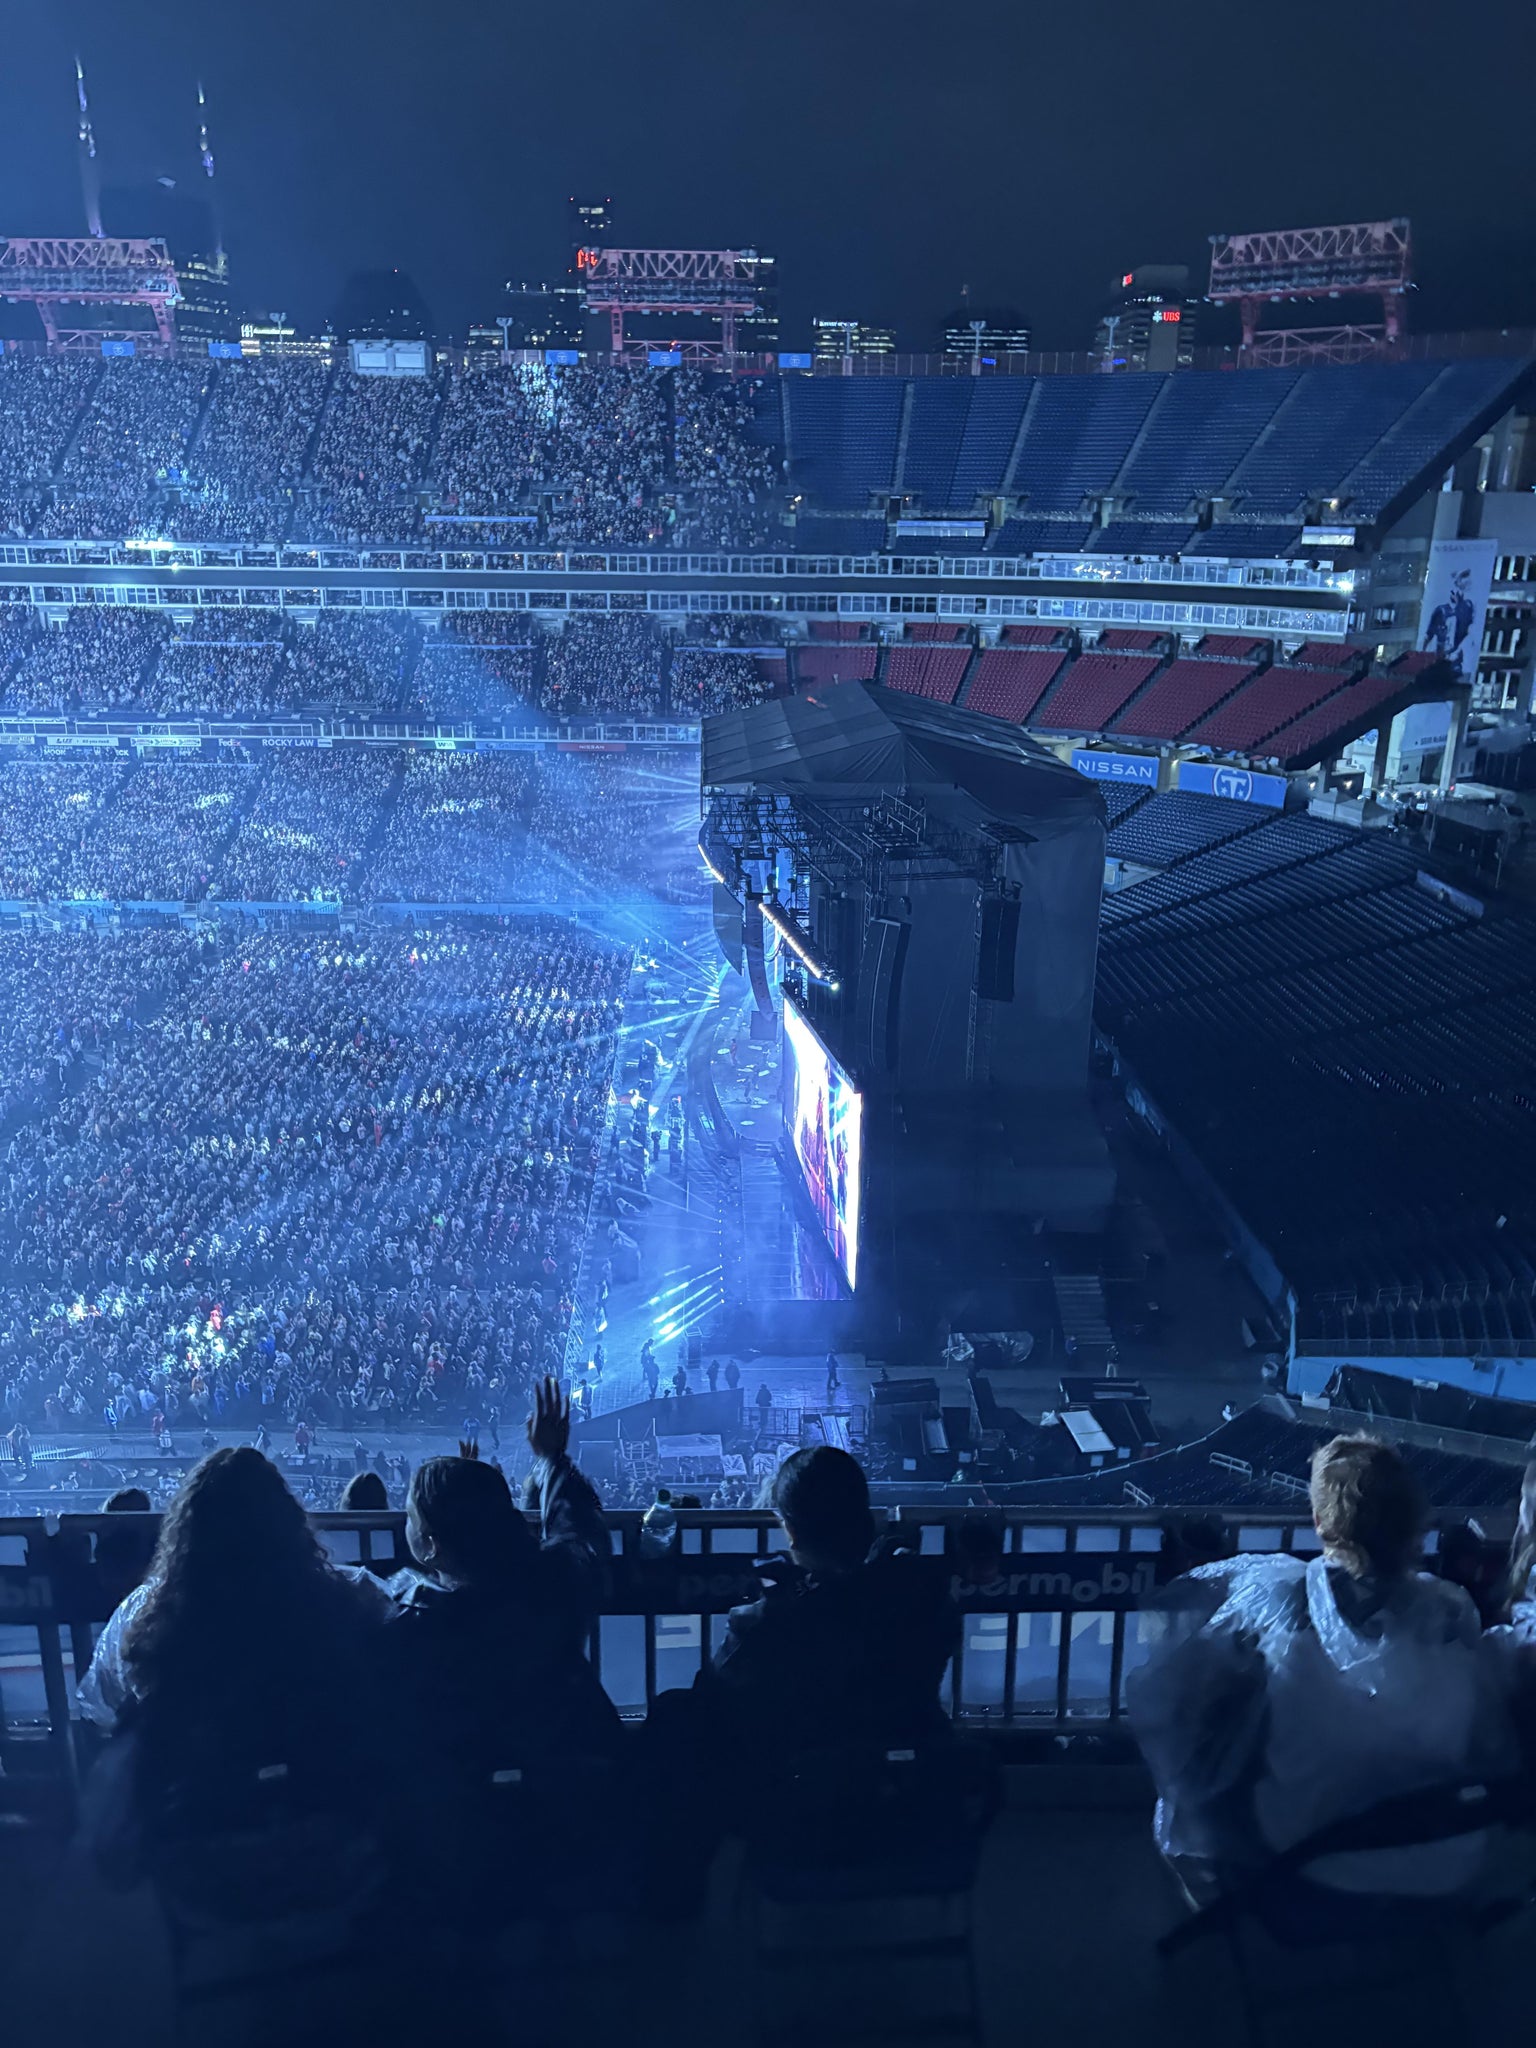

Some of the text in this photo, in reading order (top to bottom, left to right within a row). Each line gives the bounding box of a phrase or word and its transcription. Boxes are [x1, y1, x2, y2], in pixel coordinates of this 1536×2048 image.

[1163, 312, 1180, 321] UBS
[218, 738, 241, 747] FedEx
[262, 738, 293, 747] ROCKY
[294, 738, 314, 747] LAW
[1077, 759, 1153, 779] NISSAN
